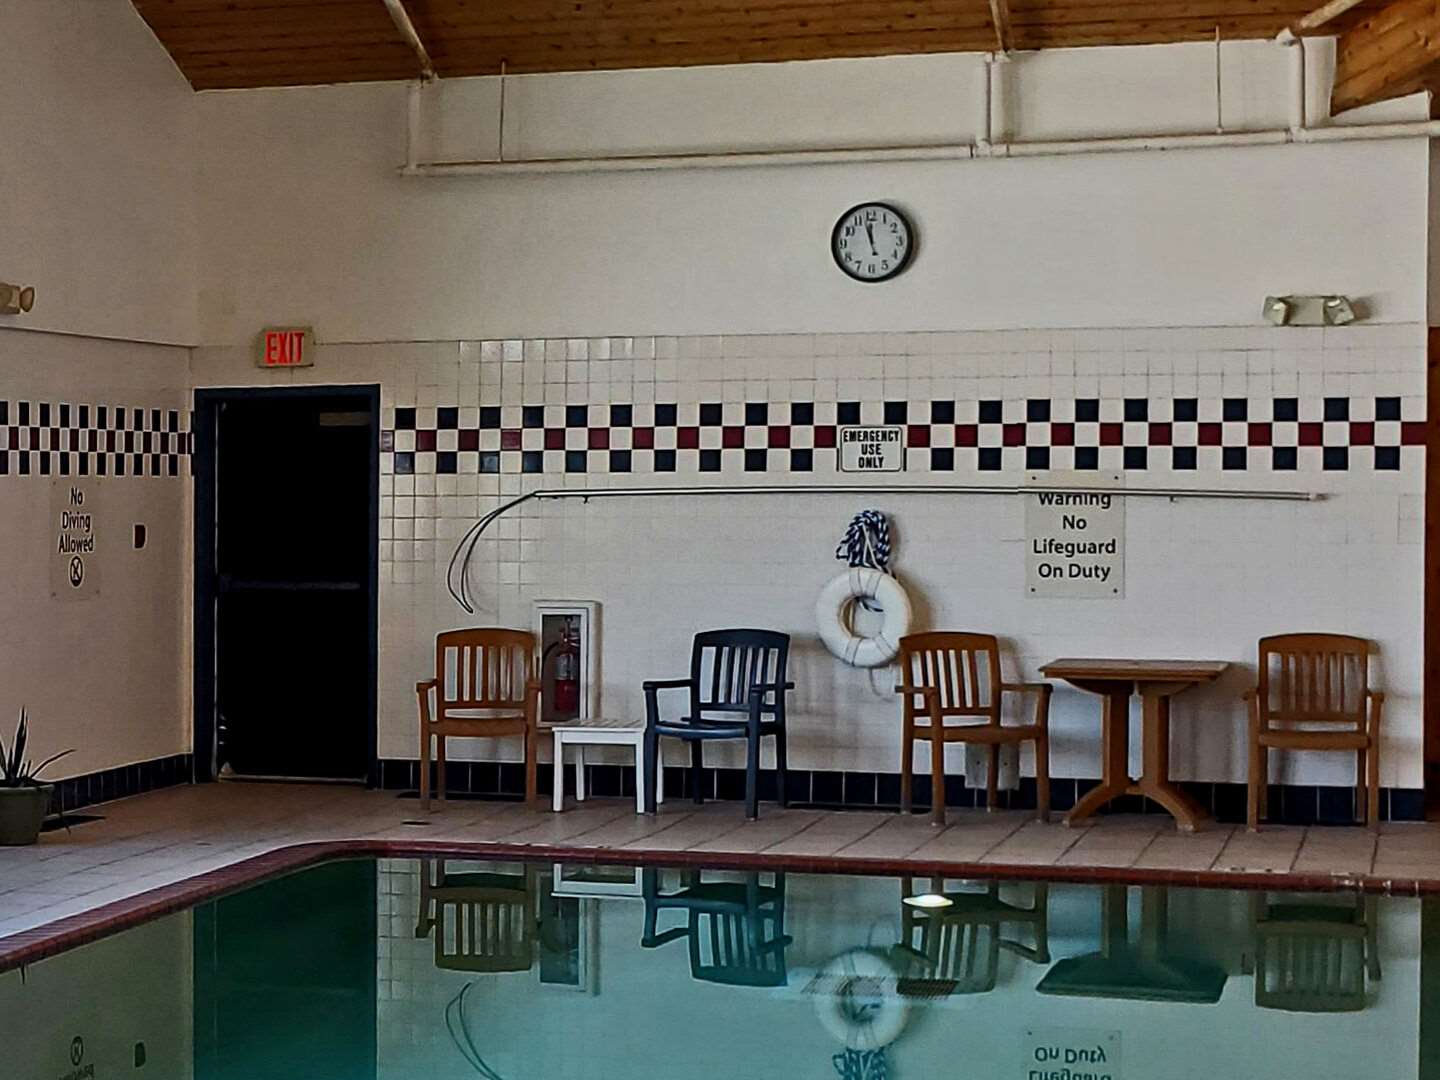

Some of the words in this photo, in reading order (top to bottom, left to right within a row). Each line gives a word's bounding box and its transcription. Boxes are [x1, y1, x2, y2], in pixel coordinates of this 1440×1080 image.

[854, 215, 863, 226] 11
[890, 222, 898, 233] 2
[896, 236, 903, 246] 3
[854, 260, 862, 272] 7
[265, 331, 305, 365] EXIT
[843, 430, 899, 442] EMERGENCY
[861, 443, 882, 455] USE
[858, 456, 884, 469] ONLY
[70, 487, 83, 505] No
[1039, 492, 1111, 510] Warning
[62, 511, 91, 533] Diving
[1062, 514, 1087, 530] No
[58, 534, 94, 553] Allowed
[1033, 538, 1116, 558] Lifeguard
[1038, 563, 1063, 578] On
[1068, 563, 1111, 582] Duty
